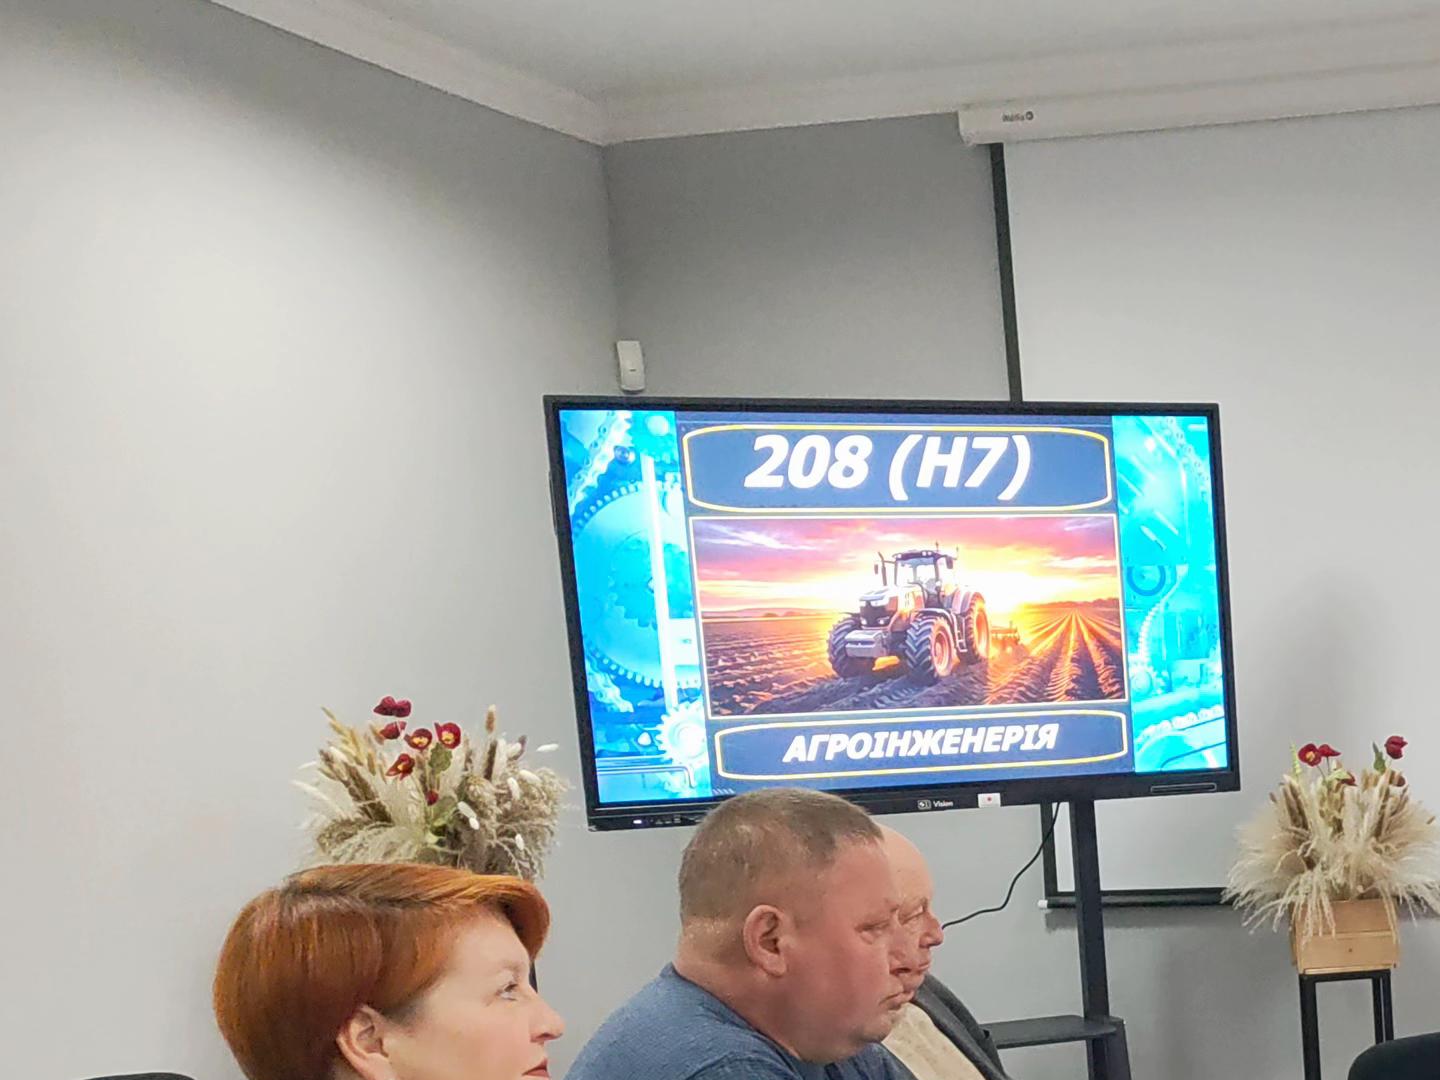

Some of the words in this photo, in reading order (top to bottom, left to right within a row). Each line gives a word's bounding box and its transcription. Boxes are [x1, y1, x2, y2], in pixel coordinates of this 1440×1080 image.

[744, 434, 873, 489] 208
[888, 434, 1032, 501] (H7)
[782, 723, 1060, 763] АГРОІНЖЕНЕРІЯ
